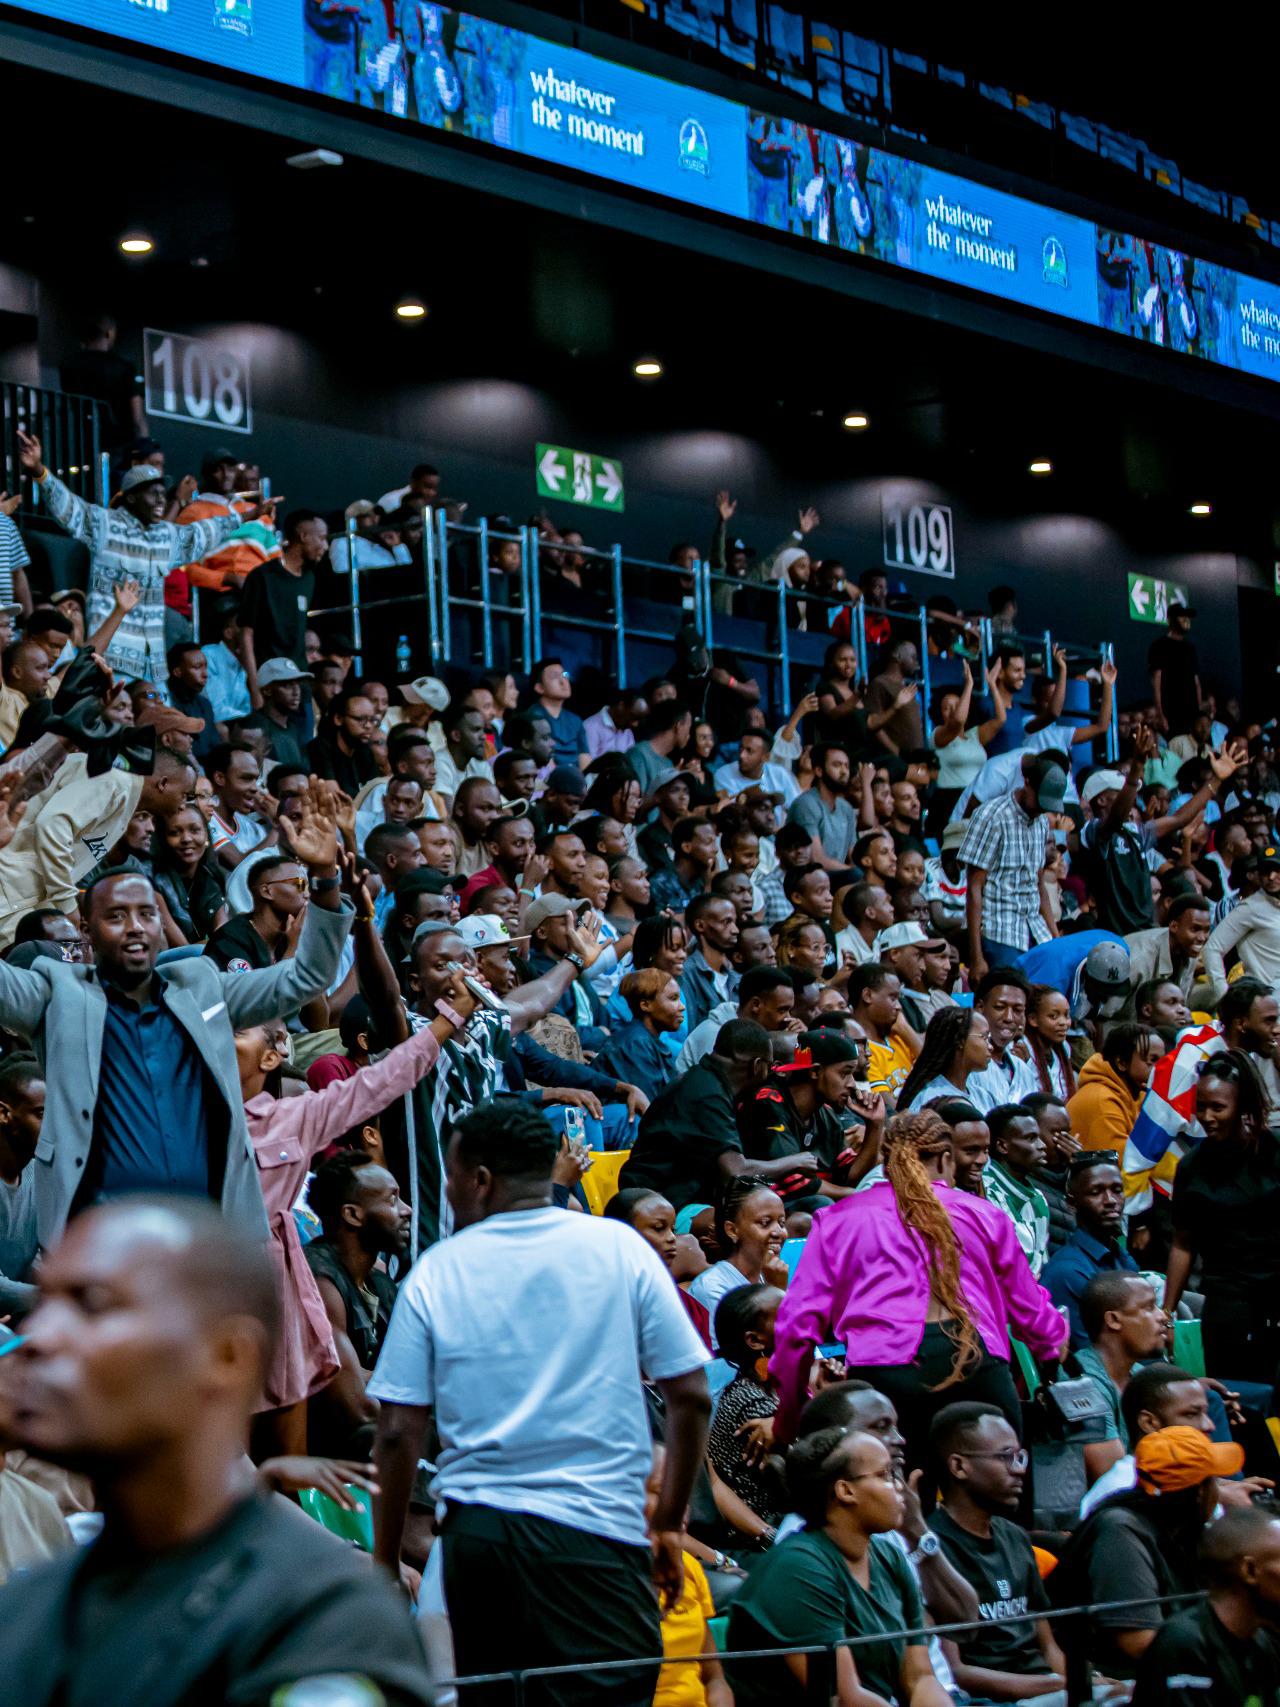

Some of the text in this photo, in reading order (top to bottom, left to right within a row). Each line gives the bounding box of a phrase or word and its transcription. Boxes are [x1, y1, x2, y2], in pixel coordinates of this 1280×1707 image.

[530, 67, 615, 116] whatever
[531, 96, 644, 156] the moment
[925, 194, 992, 237] whatever
[927, 221, 1015, 272] the moment
[1241, 322, 1260, 350] the
[153, 336, 244, 425] 108
[888, 502, 948, 571] 109
